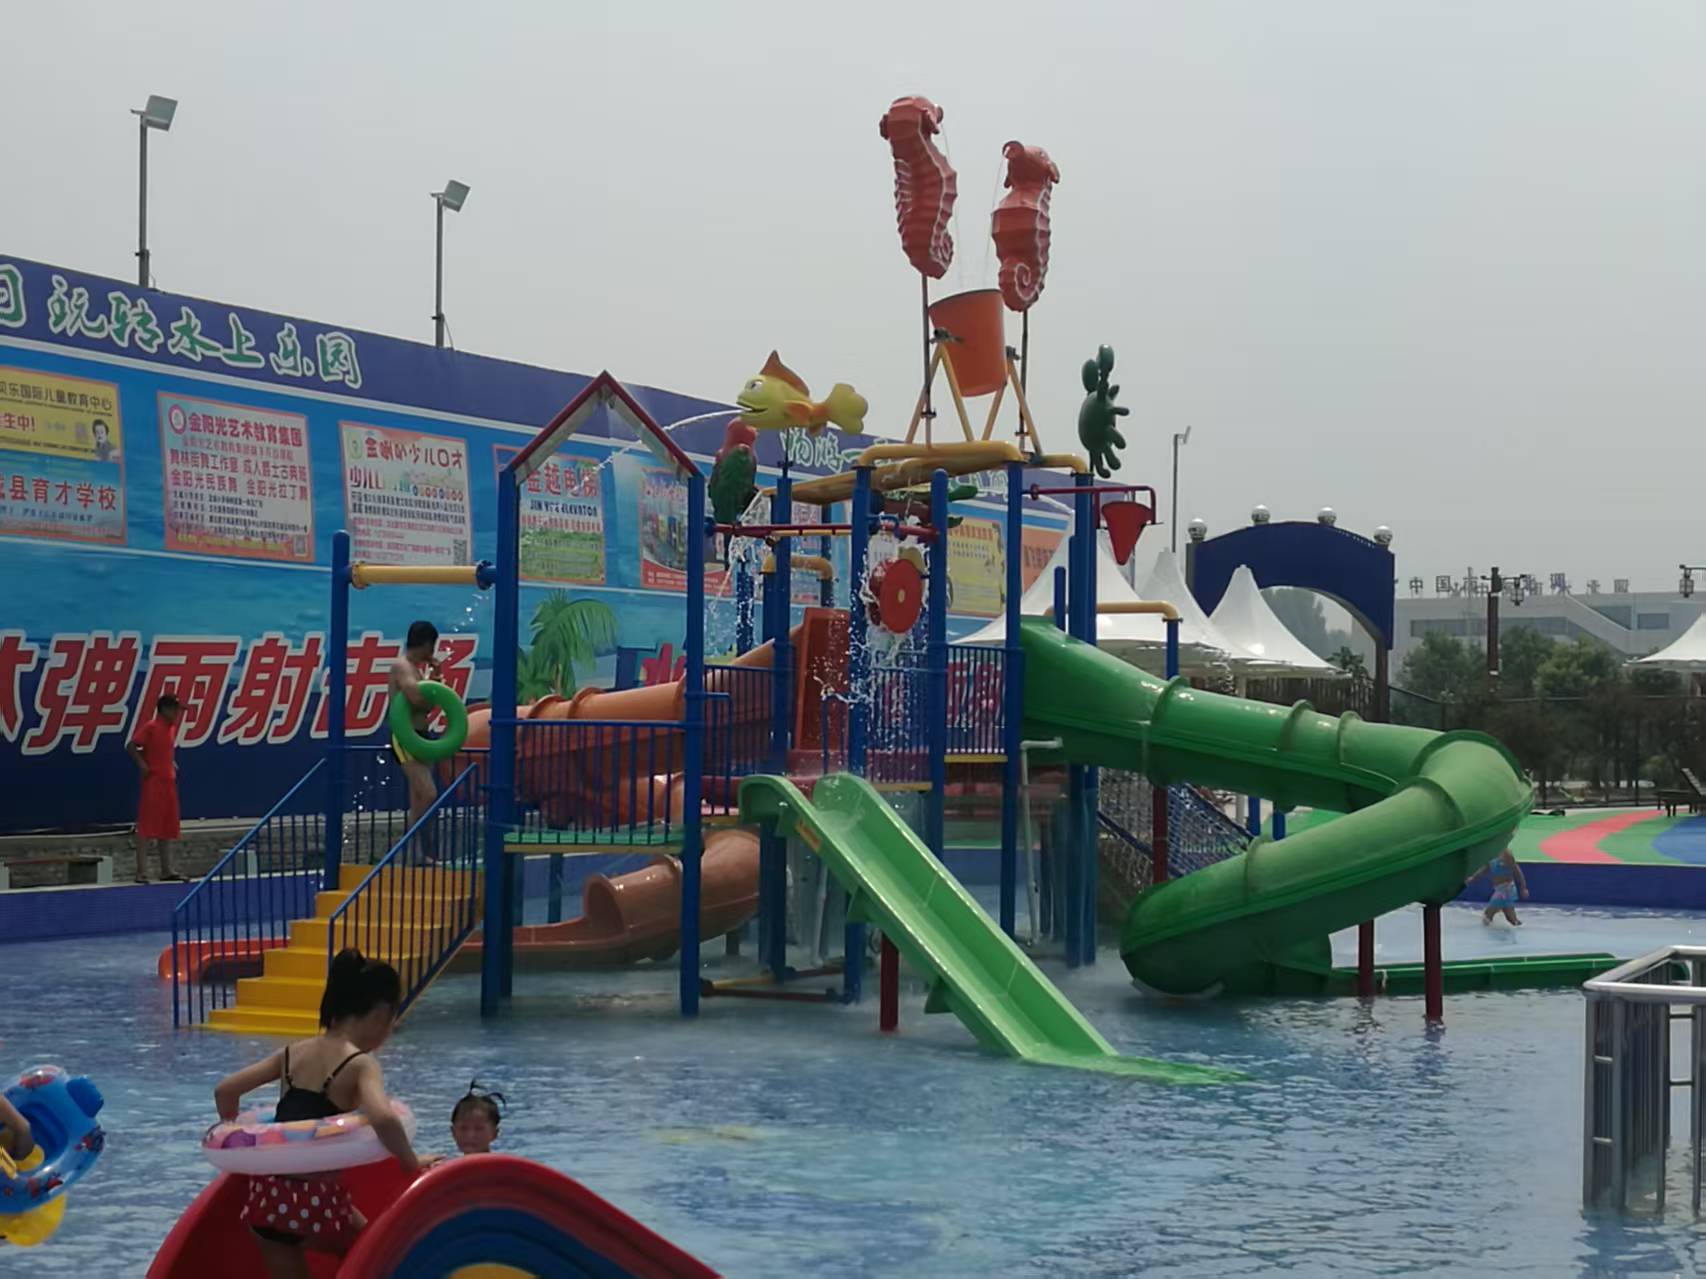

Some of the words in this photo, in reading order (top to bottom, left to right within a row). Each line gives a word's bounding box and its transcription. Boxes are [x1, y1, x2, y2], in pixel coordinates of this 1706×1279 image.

[0, 411, 36, 432] 生中!
[188, 412, 303, 447] 金阳光艺术教育集团
